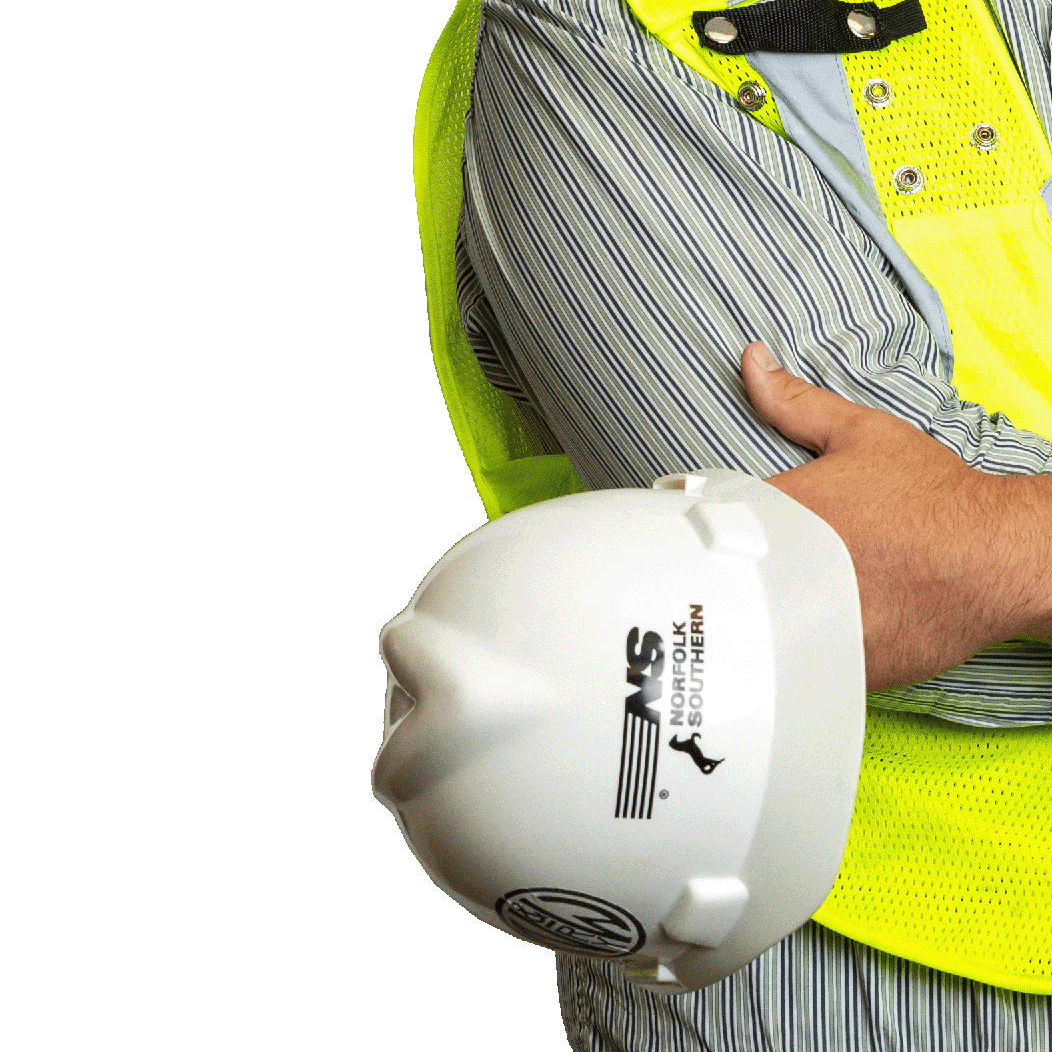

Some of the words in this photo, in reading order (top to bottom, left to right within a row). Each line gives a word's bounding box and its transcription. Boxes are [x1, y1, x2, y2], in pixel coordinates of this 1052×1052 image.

[626, 626, 665, 725] NS
[670, 621, 687, 726] NORFOLK
[687, 604, 704, 727] SOUTHERN
